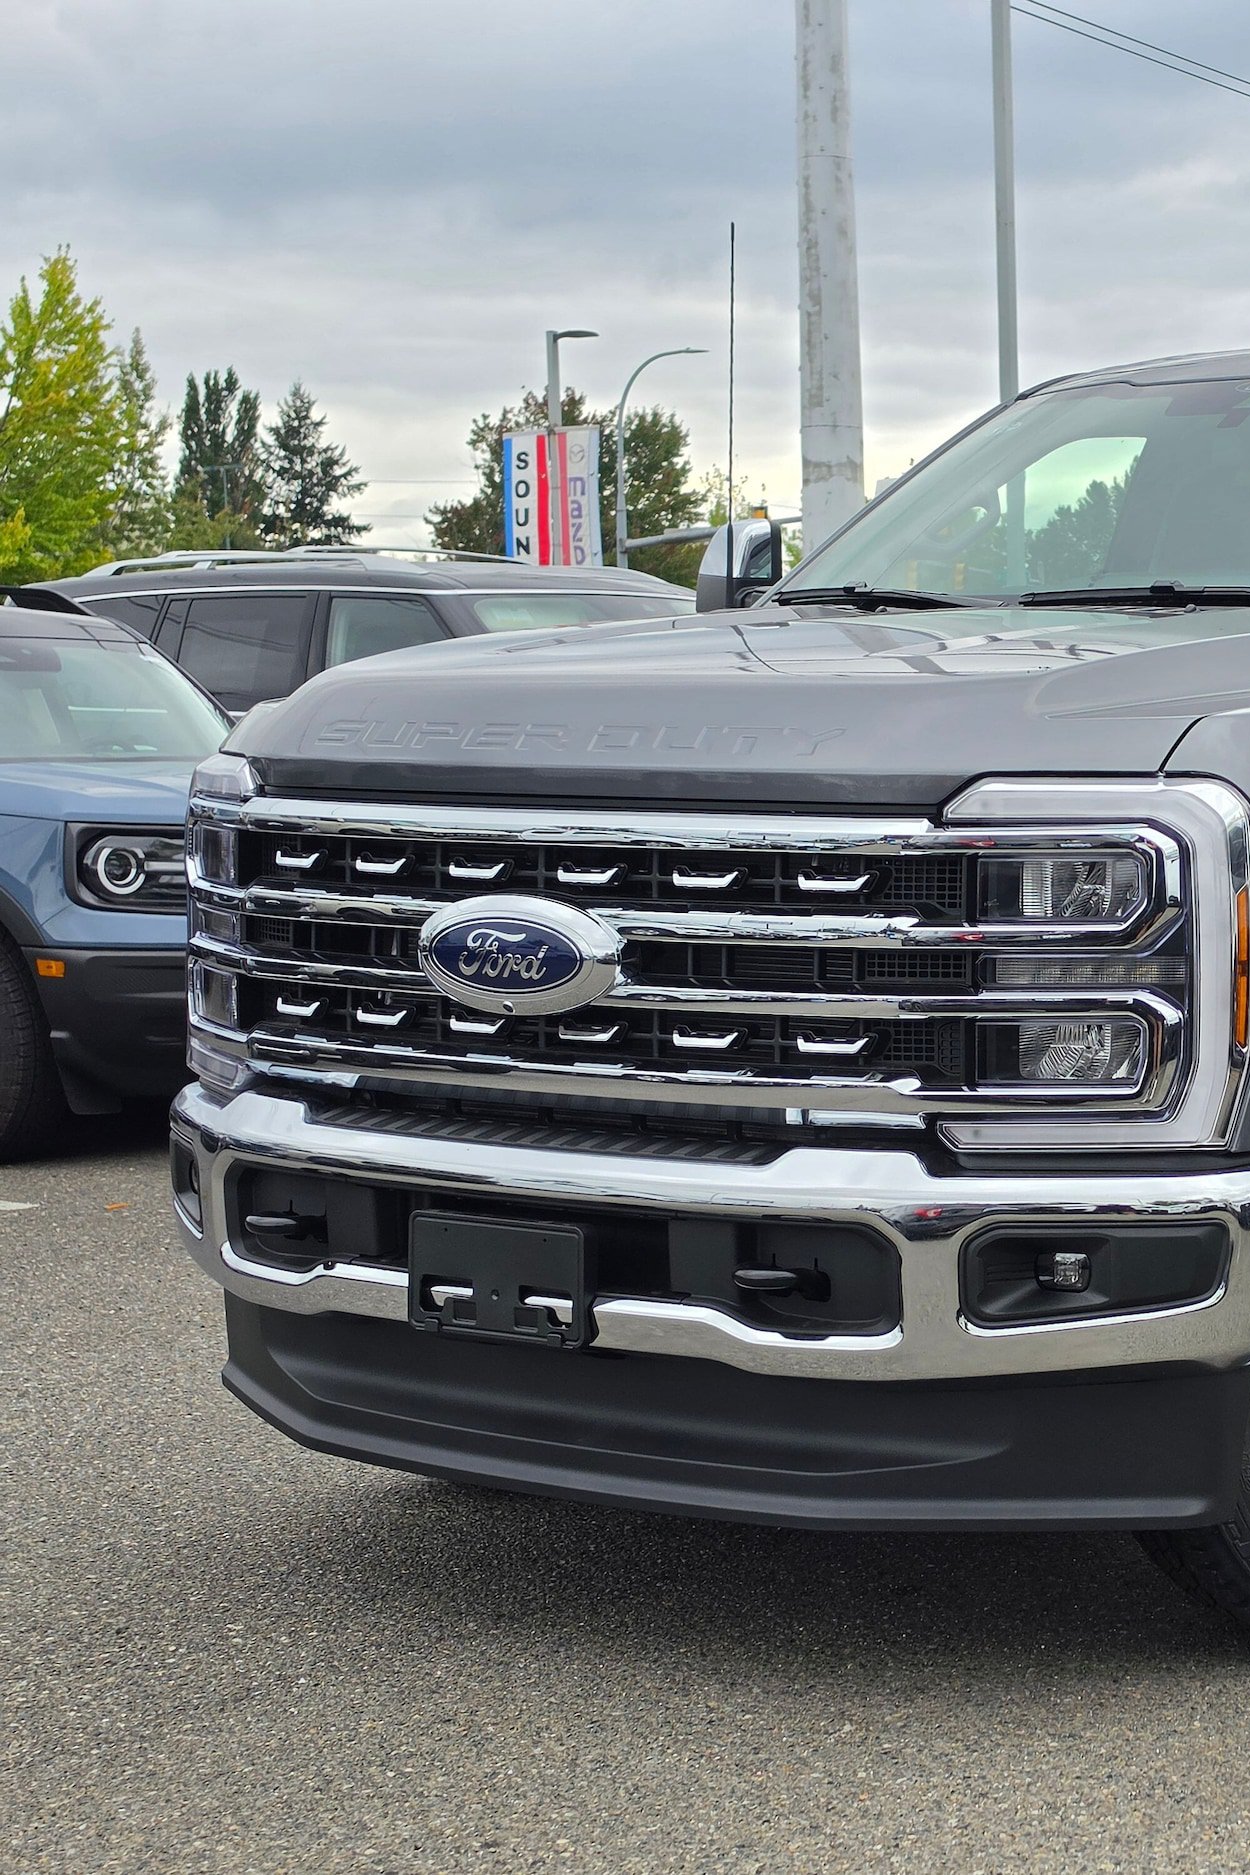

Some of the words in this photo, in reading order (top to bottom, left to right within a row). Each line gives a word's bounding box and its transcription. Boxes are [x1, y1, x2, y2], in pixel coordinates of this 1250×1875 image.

[515, 451, 530, 556] SOUN
[314, 719, 569, 752] SUPER
[586, 723, 848, 757] DUTY
[457, 927, 550, 981] Ford
